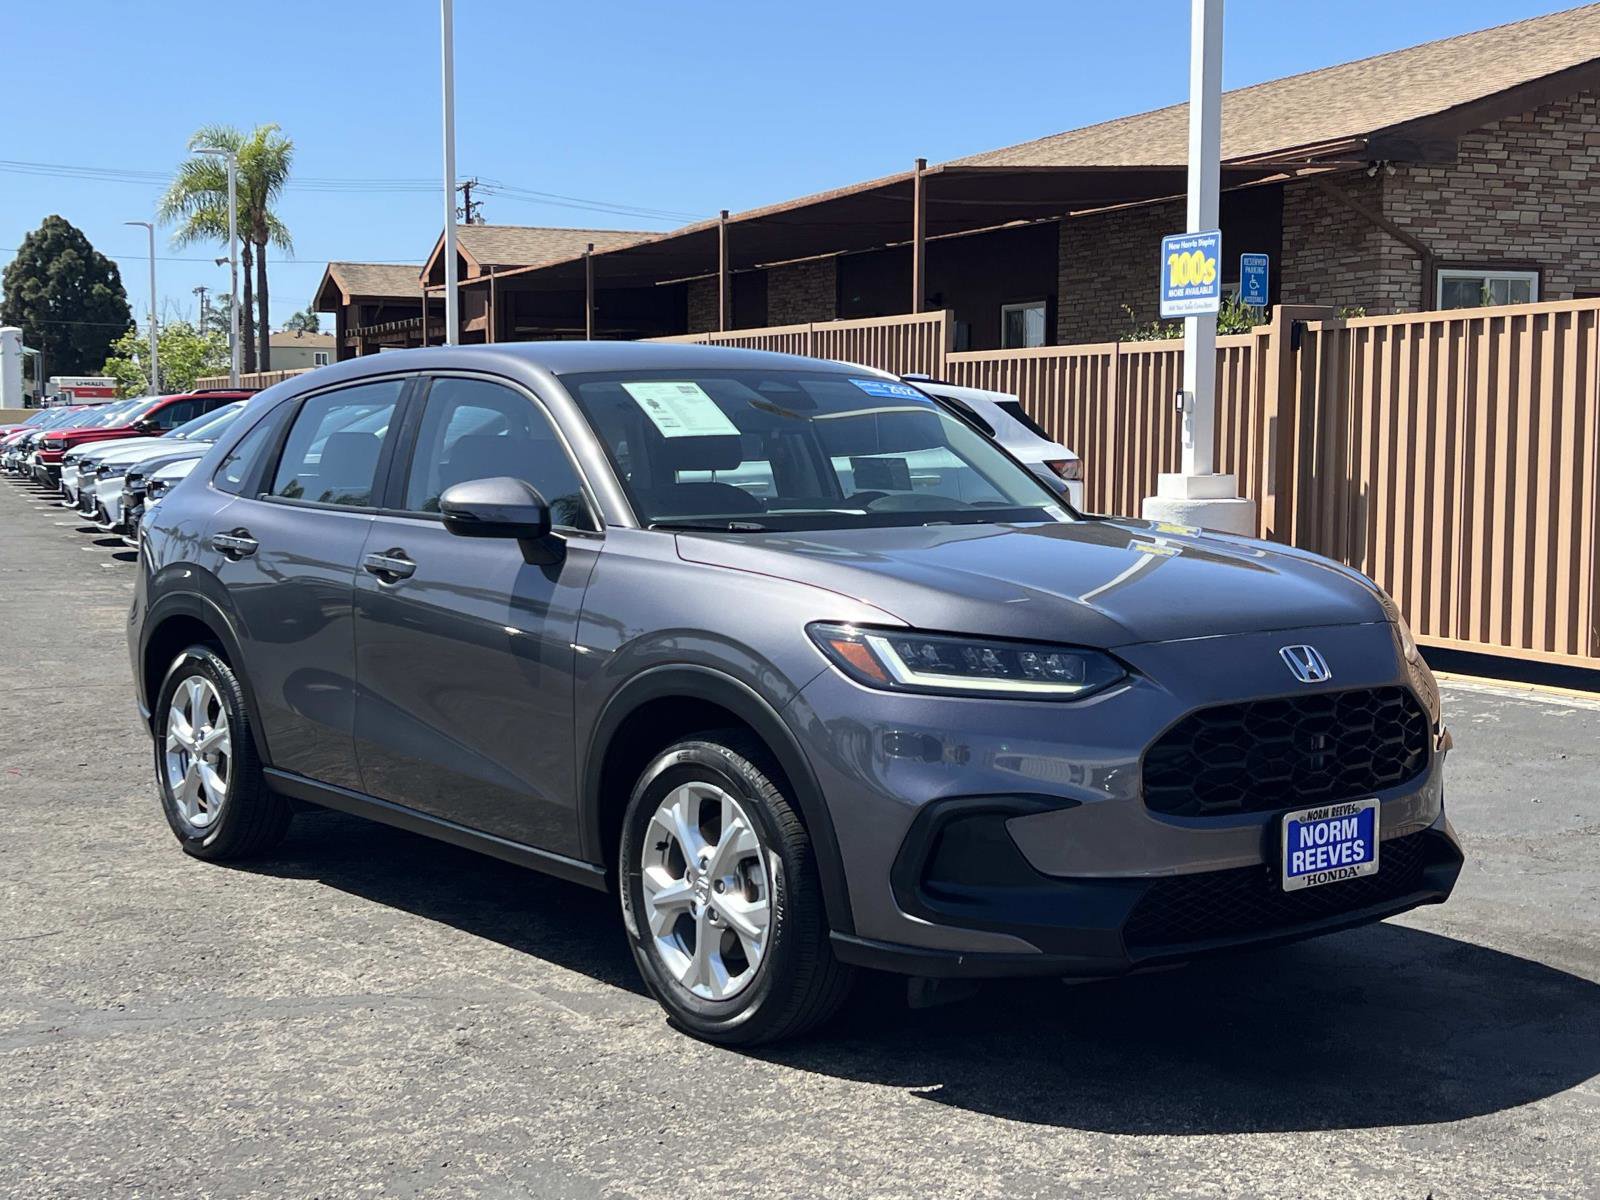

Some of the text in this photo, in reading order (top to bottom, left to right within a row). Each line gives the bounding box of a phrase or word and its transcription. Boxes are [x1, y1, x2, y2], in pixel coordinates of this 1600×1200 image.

[1168, 242, 1180, 250] New
[1198, 237, 1216, 248] Display
[1168, 250, 1216, 287] 100s
[1168, 288, 1184, 297] MORE
[1307, 804, 1356, 821] NORM REEVES
[1300, 817, 1358, 848] NORM
[1292, 839, 1365, 874] REEVES
